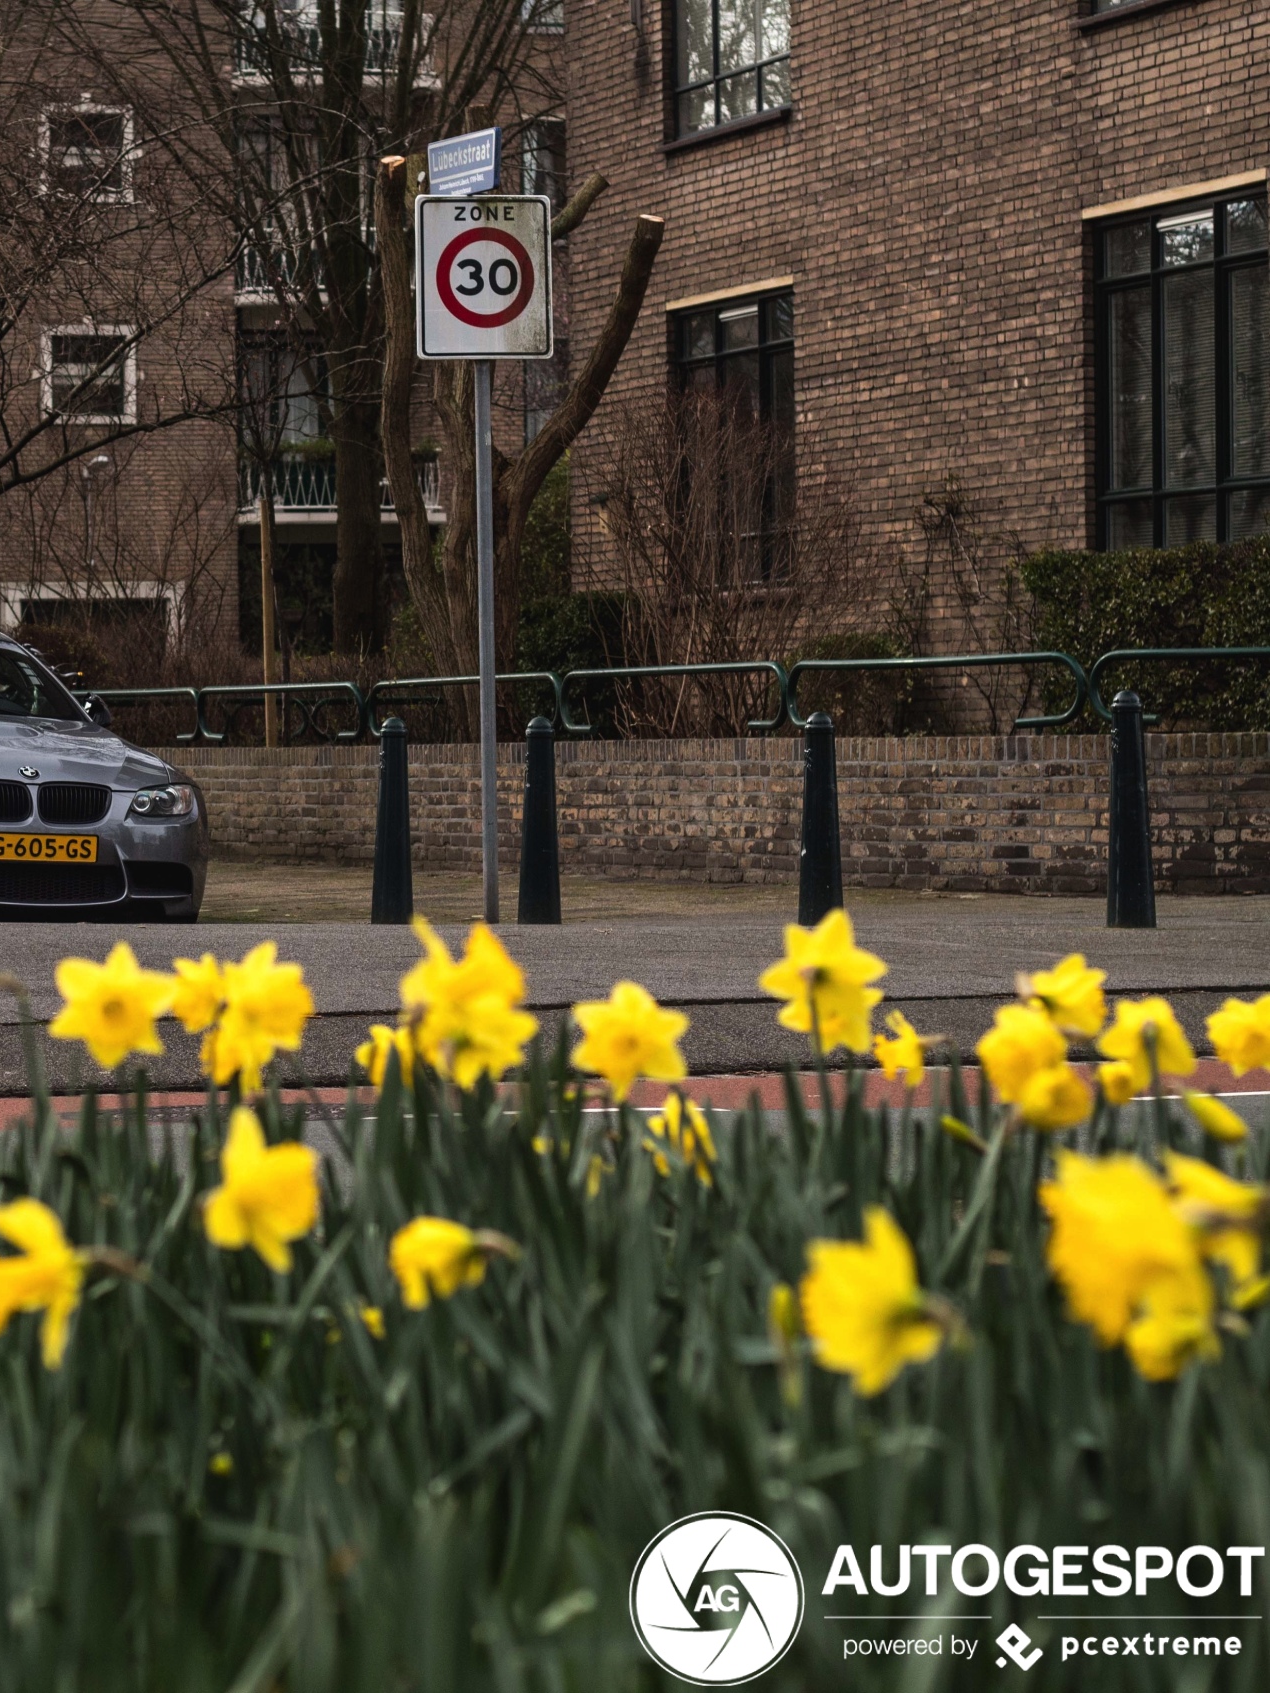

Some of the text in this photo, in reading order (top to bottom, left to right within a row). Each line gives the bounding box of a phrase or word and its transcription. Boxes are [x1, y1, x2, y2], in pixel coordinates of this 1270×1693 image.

[432, 139, 491, 172] Lübeckstraat
[454, 206, 515, 221] ZONE
[455, 258, 518, 296] 30
